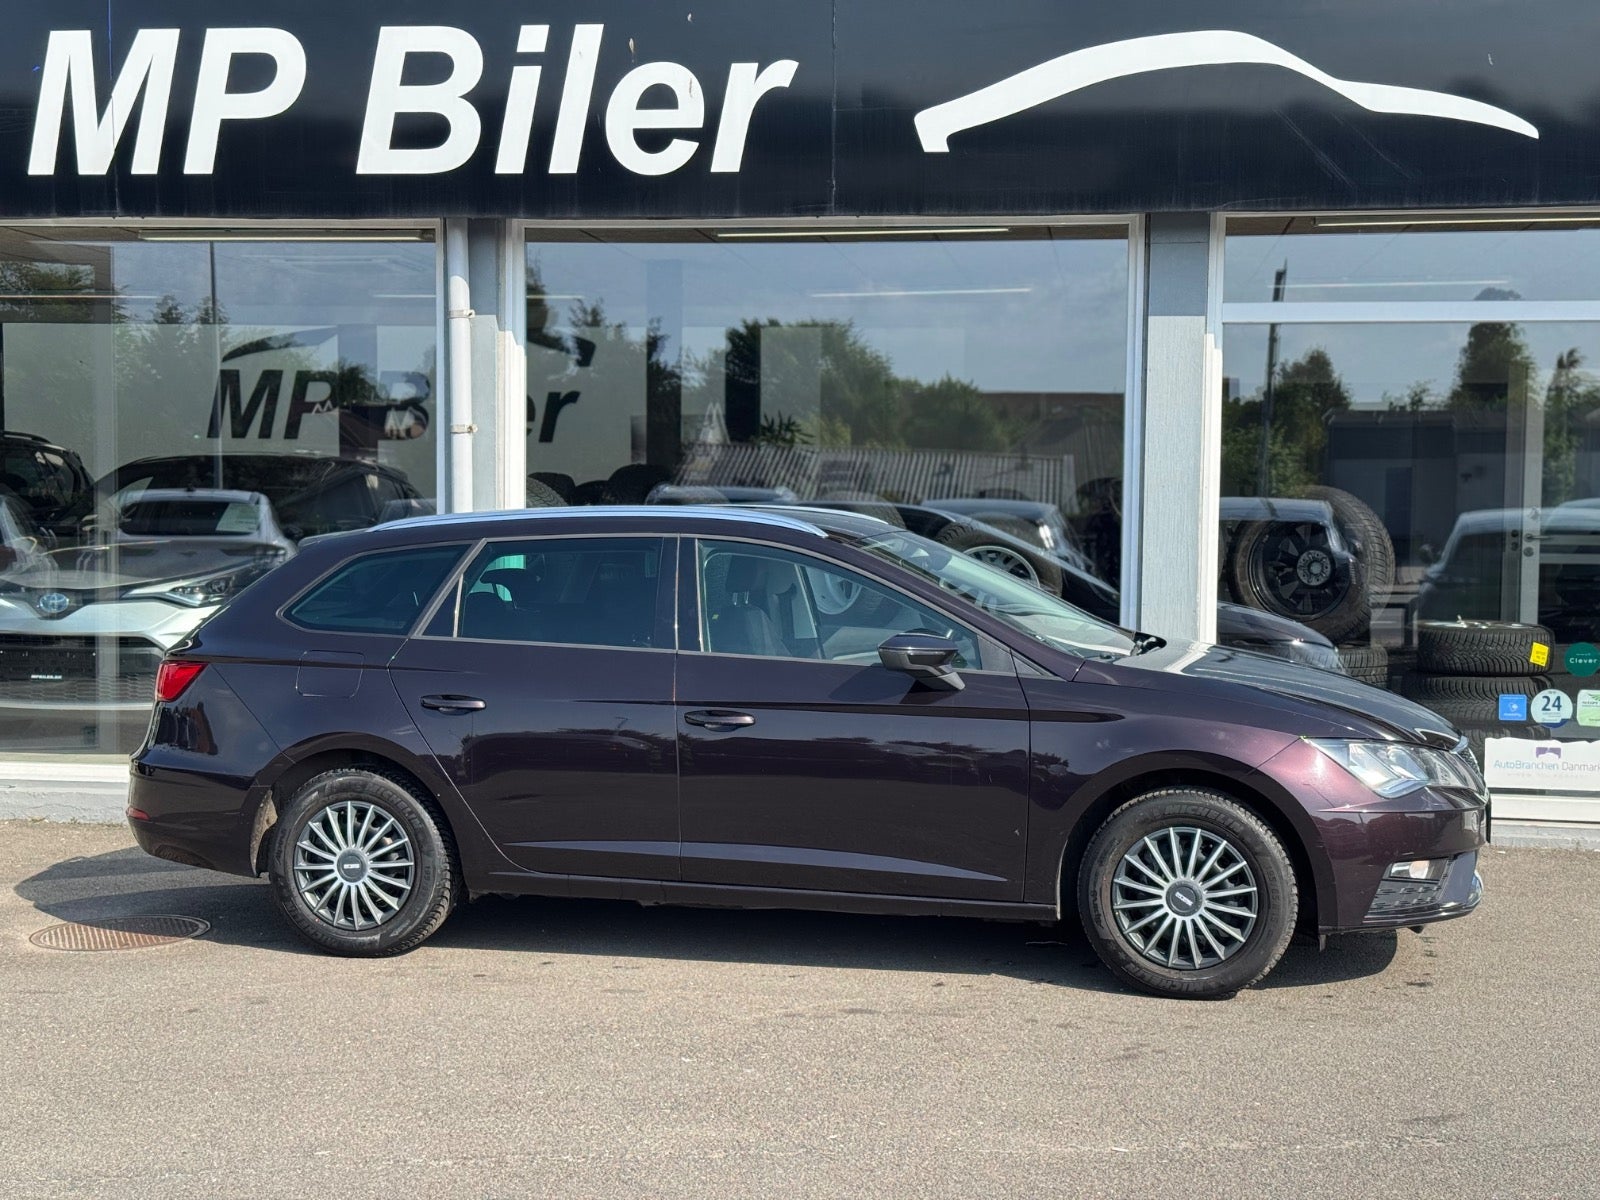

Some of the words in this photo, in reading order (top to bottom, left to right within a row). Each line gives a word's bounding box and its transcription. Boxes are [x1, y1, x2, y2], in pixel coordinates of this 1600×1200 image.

[27, 27, 307, 176] MP
[355, 23, 800, 176] Biler
[206, 368, 338, 440] MP
[1541, 695, 1562, 712] 24
[1493, 759, 1559, 771] AutoBranchen
[1162, 803, 1243, 834] MICHELIN
